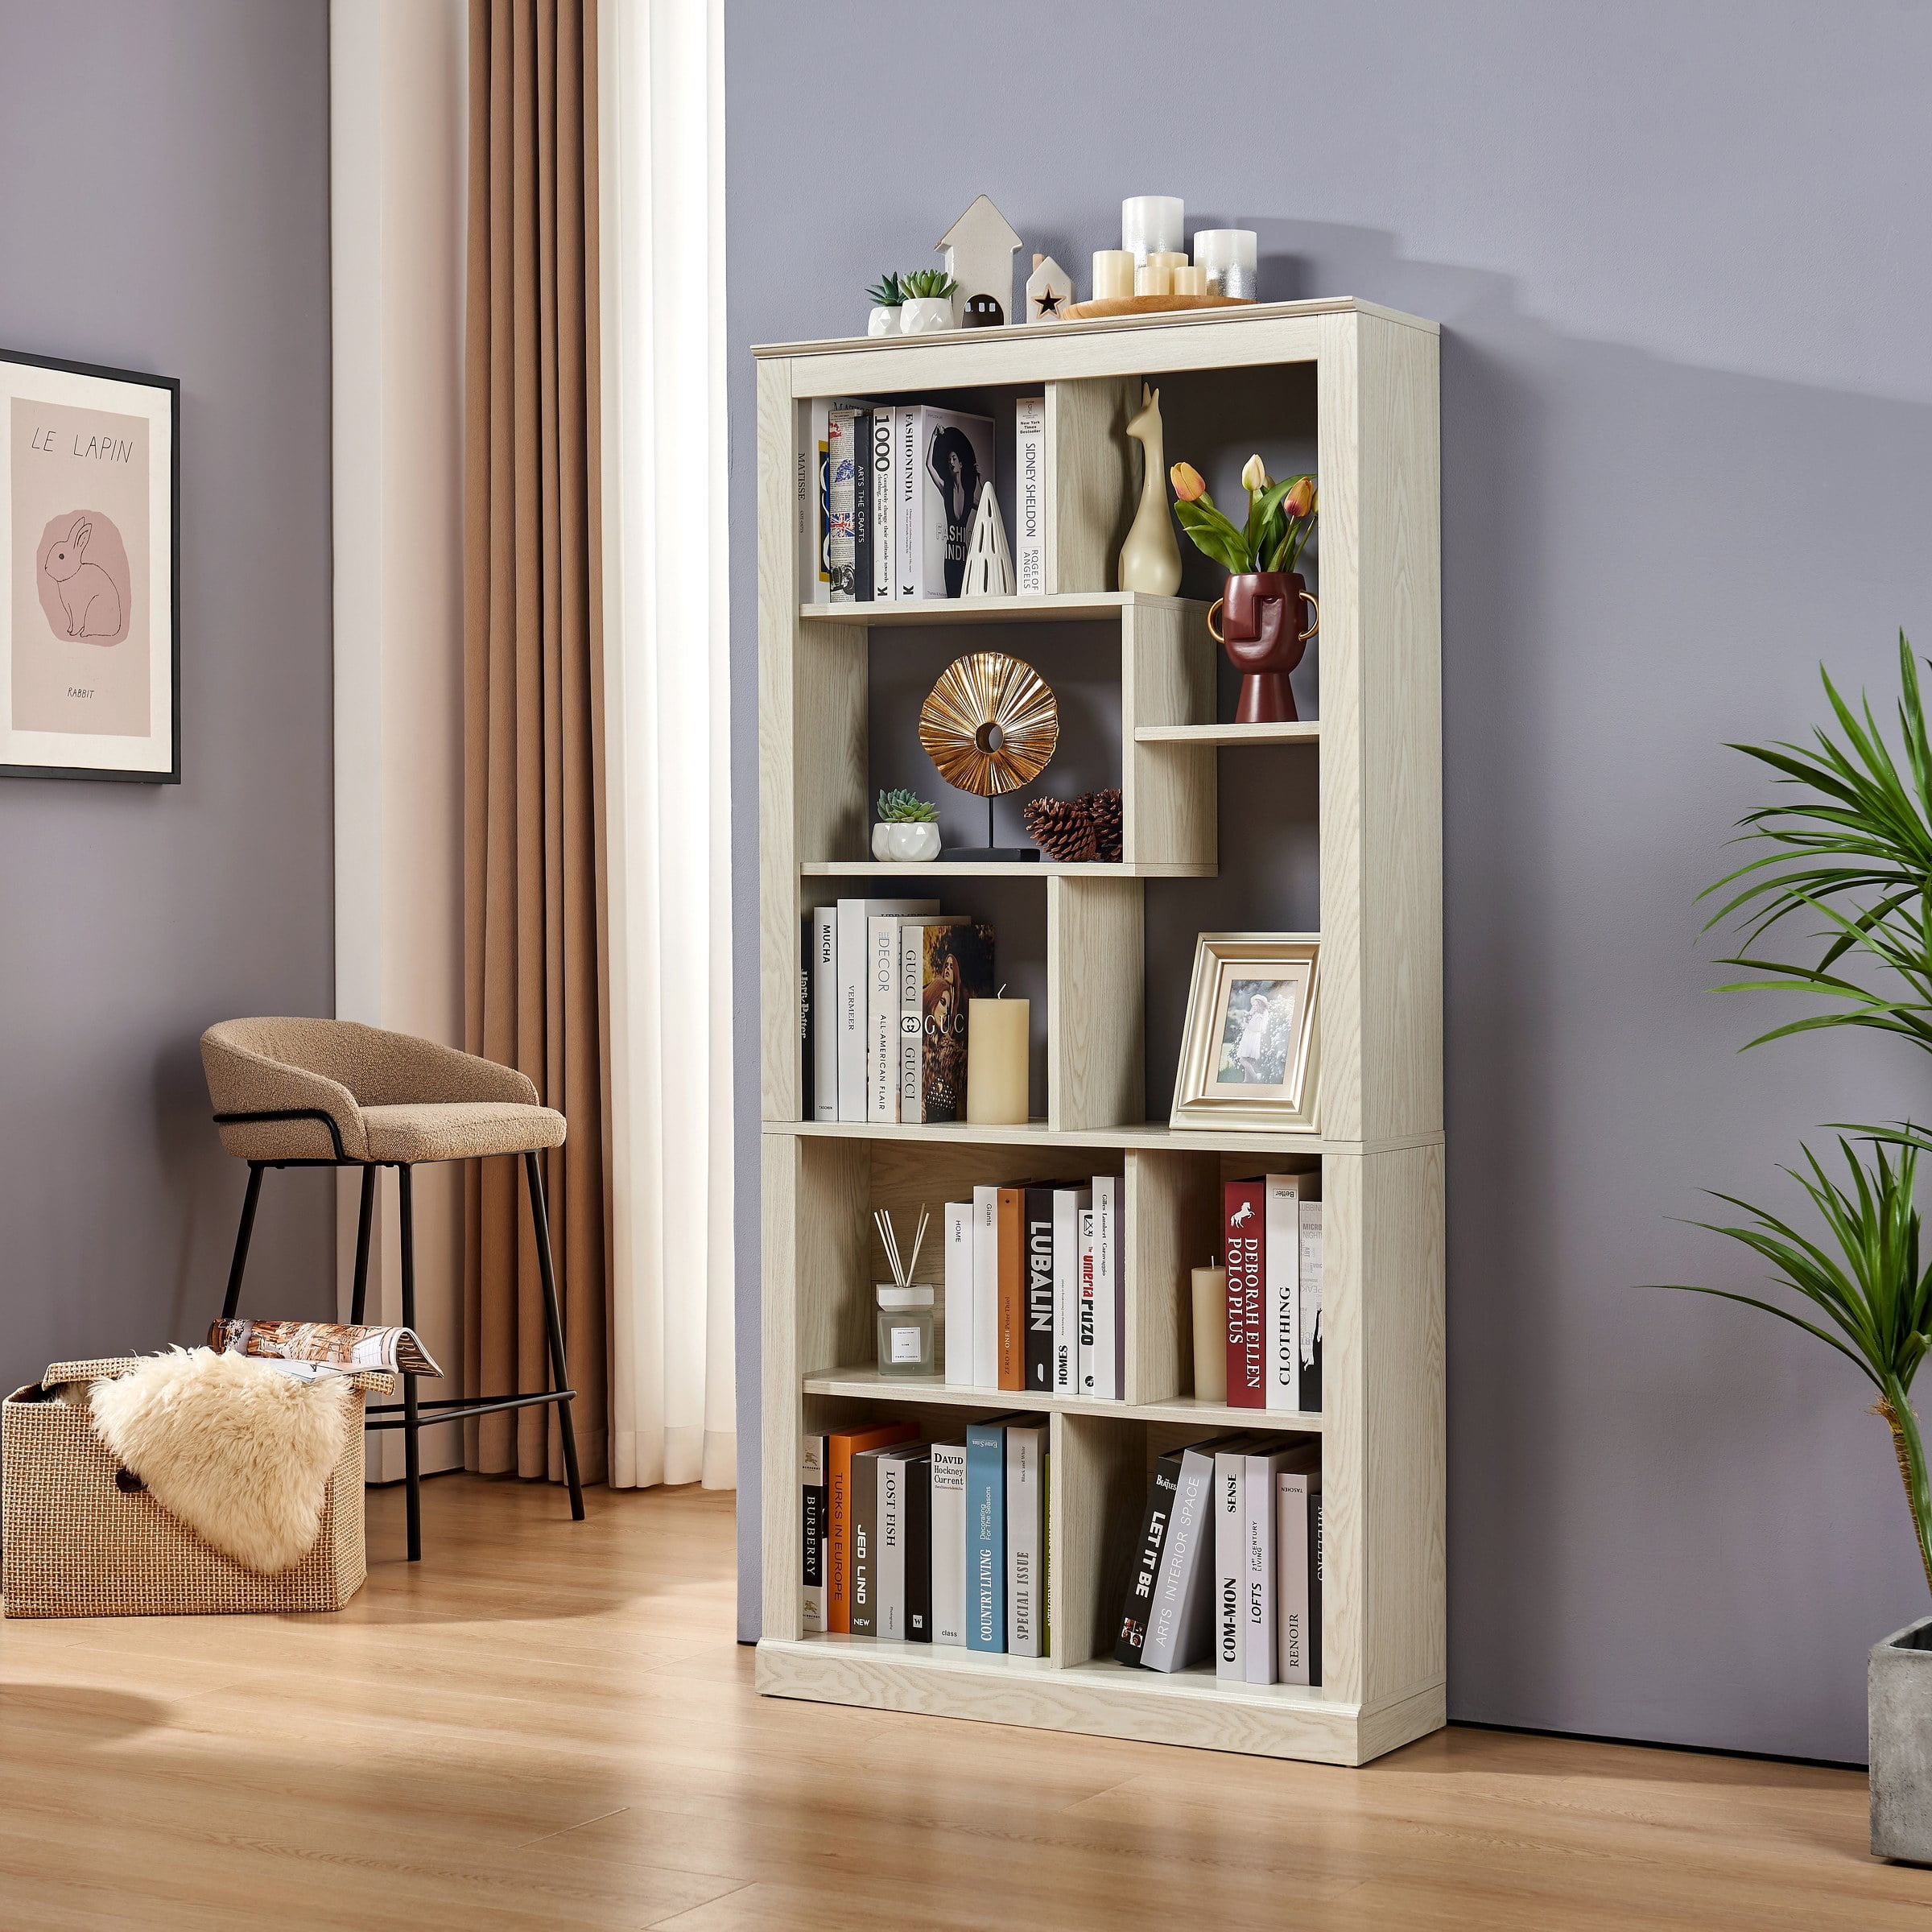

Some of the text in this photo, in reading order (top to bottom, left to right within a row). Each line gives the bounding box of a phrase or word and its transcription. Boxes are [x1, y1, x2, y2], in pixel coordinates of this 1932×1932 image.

[32, 427, 133, 463] LE LAPIN
[874, 414, 890, 473] 1000
[905, 413, 913, 502] FASHIONINDIA
[798, 452, 806, 501] MATISSE
[1026, 443, 1036, 537] SIDNEY SHELDON
[945, 542, 965, 562] INDI
[1032, 578, 1039, 591] OF
[67, 687, 95, 699] RABBIT
[823, 925, 831, 964] MUCHA
[878, 938, 890, 992] DECOR
[905, 949, 916, 1003] GUCCI
[925, 1014, 964, 1034] GUC
[905, 1047, 916, 1100] GUCCI
[1302, 1231, 1322, 1239] NIGHT
[1030, 1222, 1052, 1331] LUBALIN
[1228, 1237, 1244, 1344] POLO PLUS
[1245, 1238, 1260, 1388] DEBORAH ELLEN
[1279, 1286, 1291, 1386] CLOTHING
[1059, 1345, 1068, 1385] HOMES
[934, 1453, 964, 1465] DAVID
[934, 1465, 964, 1477] Hockney
[934, 1475, 964, 1485] Current
[1156, 1474, 1177, 1491] BEATLES
[807, 1496, 815, 1576] BURBERRY
[835, 1524, 842, 1536] IN
[886, 1471, 896, 1547] LOST FISH
[834, 1539, 842, 1601] EUROPE
[857, 1524, 866, 1604] JED LIND
[1135, 1511, 1166, 1598] LET IT BE
[1156, 1476, 1200, 1647] ARTS INTERIOR SPACE
[1223, 1473, 1236, 1663] COM-MON SENSE
[914, 1618, 922, 1626] W
[980, 1549, 992, 1641] COUNTRY LIVING
[1017, 1551, 1029, 1640] SPECIAL ISSUE
[1251, 1583, 1262, 1624] LOFTS
[853, 1618, 870, 1627] NEW
[1290, 1613, 1298, 1668] RENOIR
